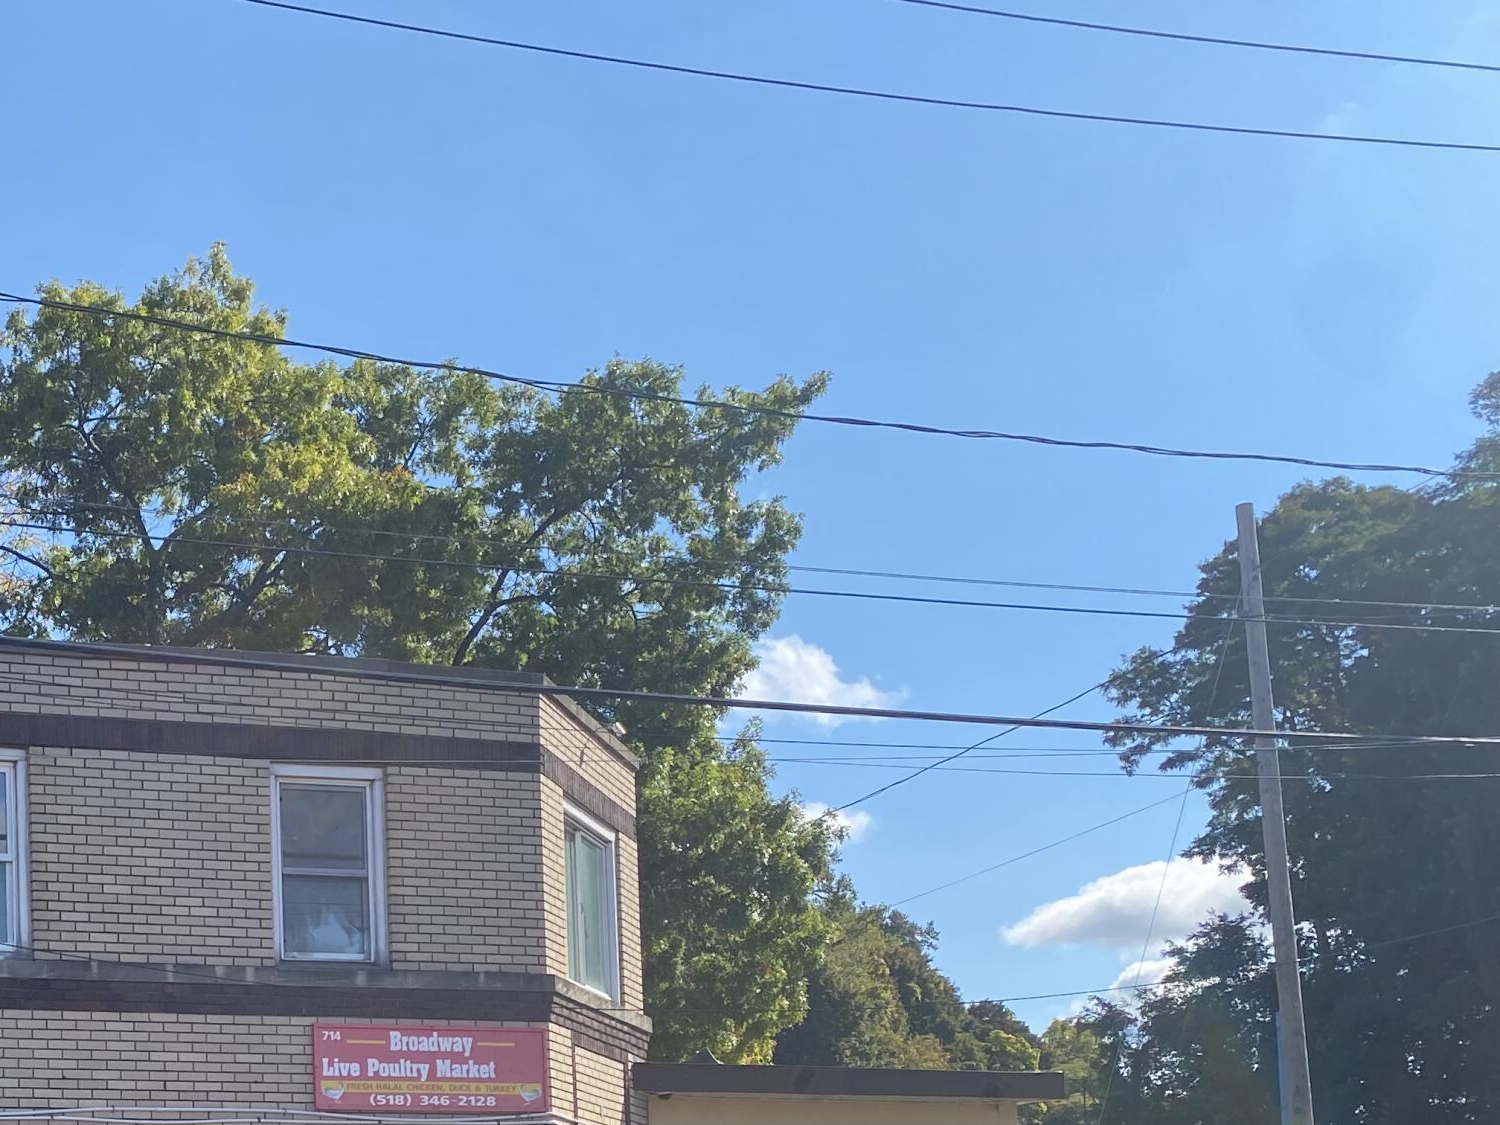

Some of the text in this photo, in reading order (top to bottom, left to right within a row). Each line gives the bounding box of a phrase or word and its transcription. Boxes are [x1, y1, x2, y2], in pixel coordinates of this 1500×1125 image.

[322, 1031, 341, 1041] 714
[389, 1030, 473, 1057] Broadway
[322, 1057, 496, 1081] Live Poultry Market
[346, 1083, 373, 1092] FRESH
[376, 1083, 403, 1092] HALAL
[370, 1094, 496, 1107] (518) 346-2128
